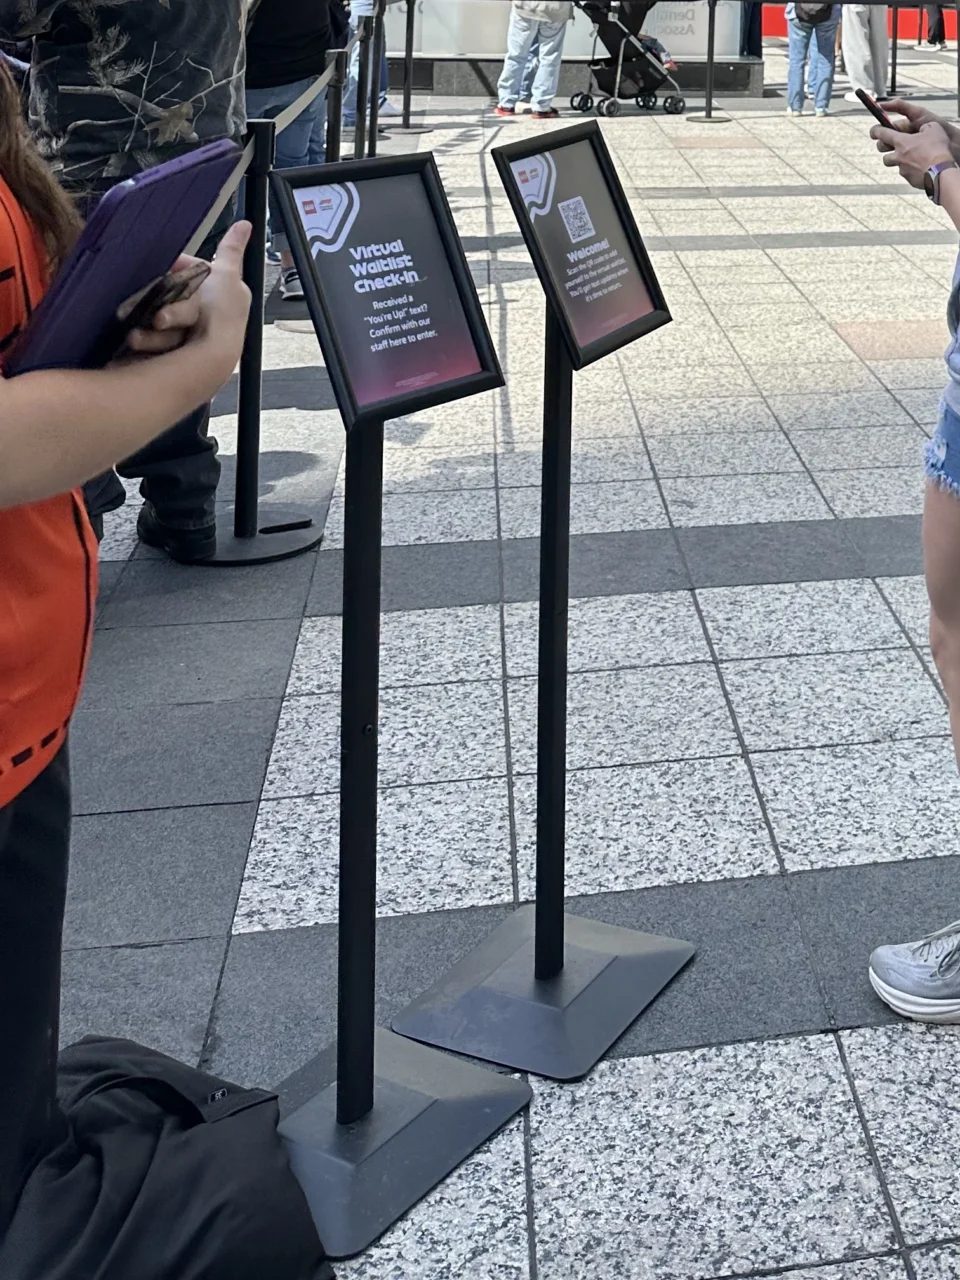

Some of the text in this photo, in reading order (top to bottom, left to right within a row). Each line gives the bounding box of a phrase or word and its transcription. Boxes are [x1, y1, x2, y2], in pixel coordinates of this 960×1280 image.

[349, 239, 404, 261] Virtual
[567, 238, 610, 263] Welcome!
[349, 254, 413, 277] Waitlist
[372, 294, 408, 310] Received
[409, 303, 428, 315] text?
[369, 318, 431, 338] Confirm with our
[370, 330, 439, 352] staff here to enter.
